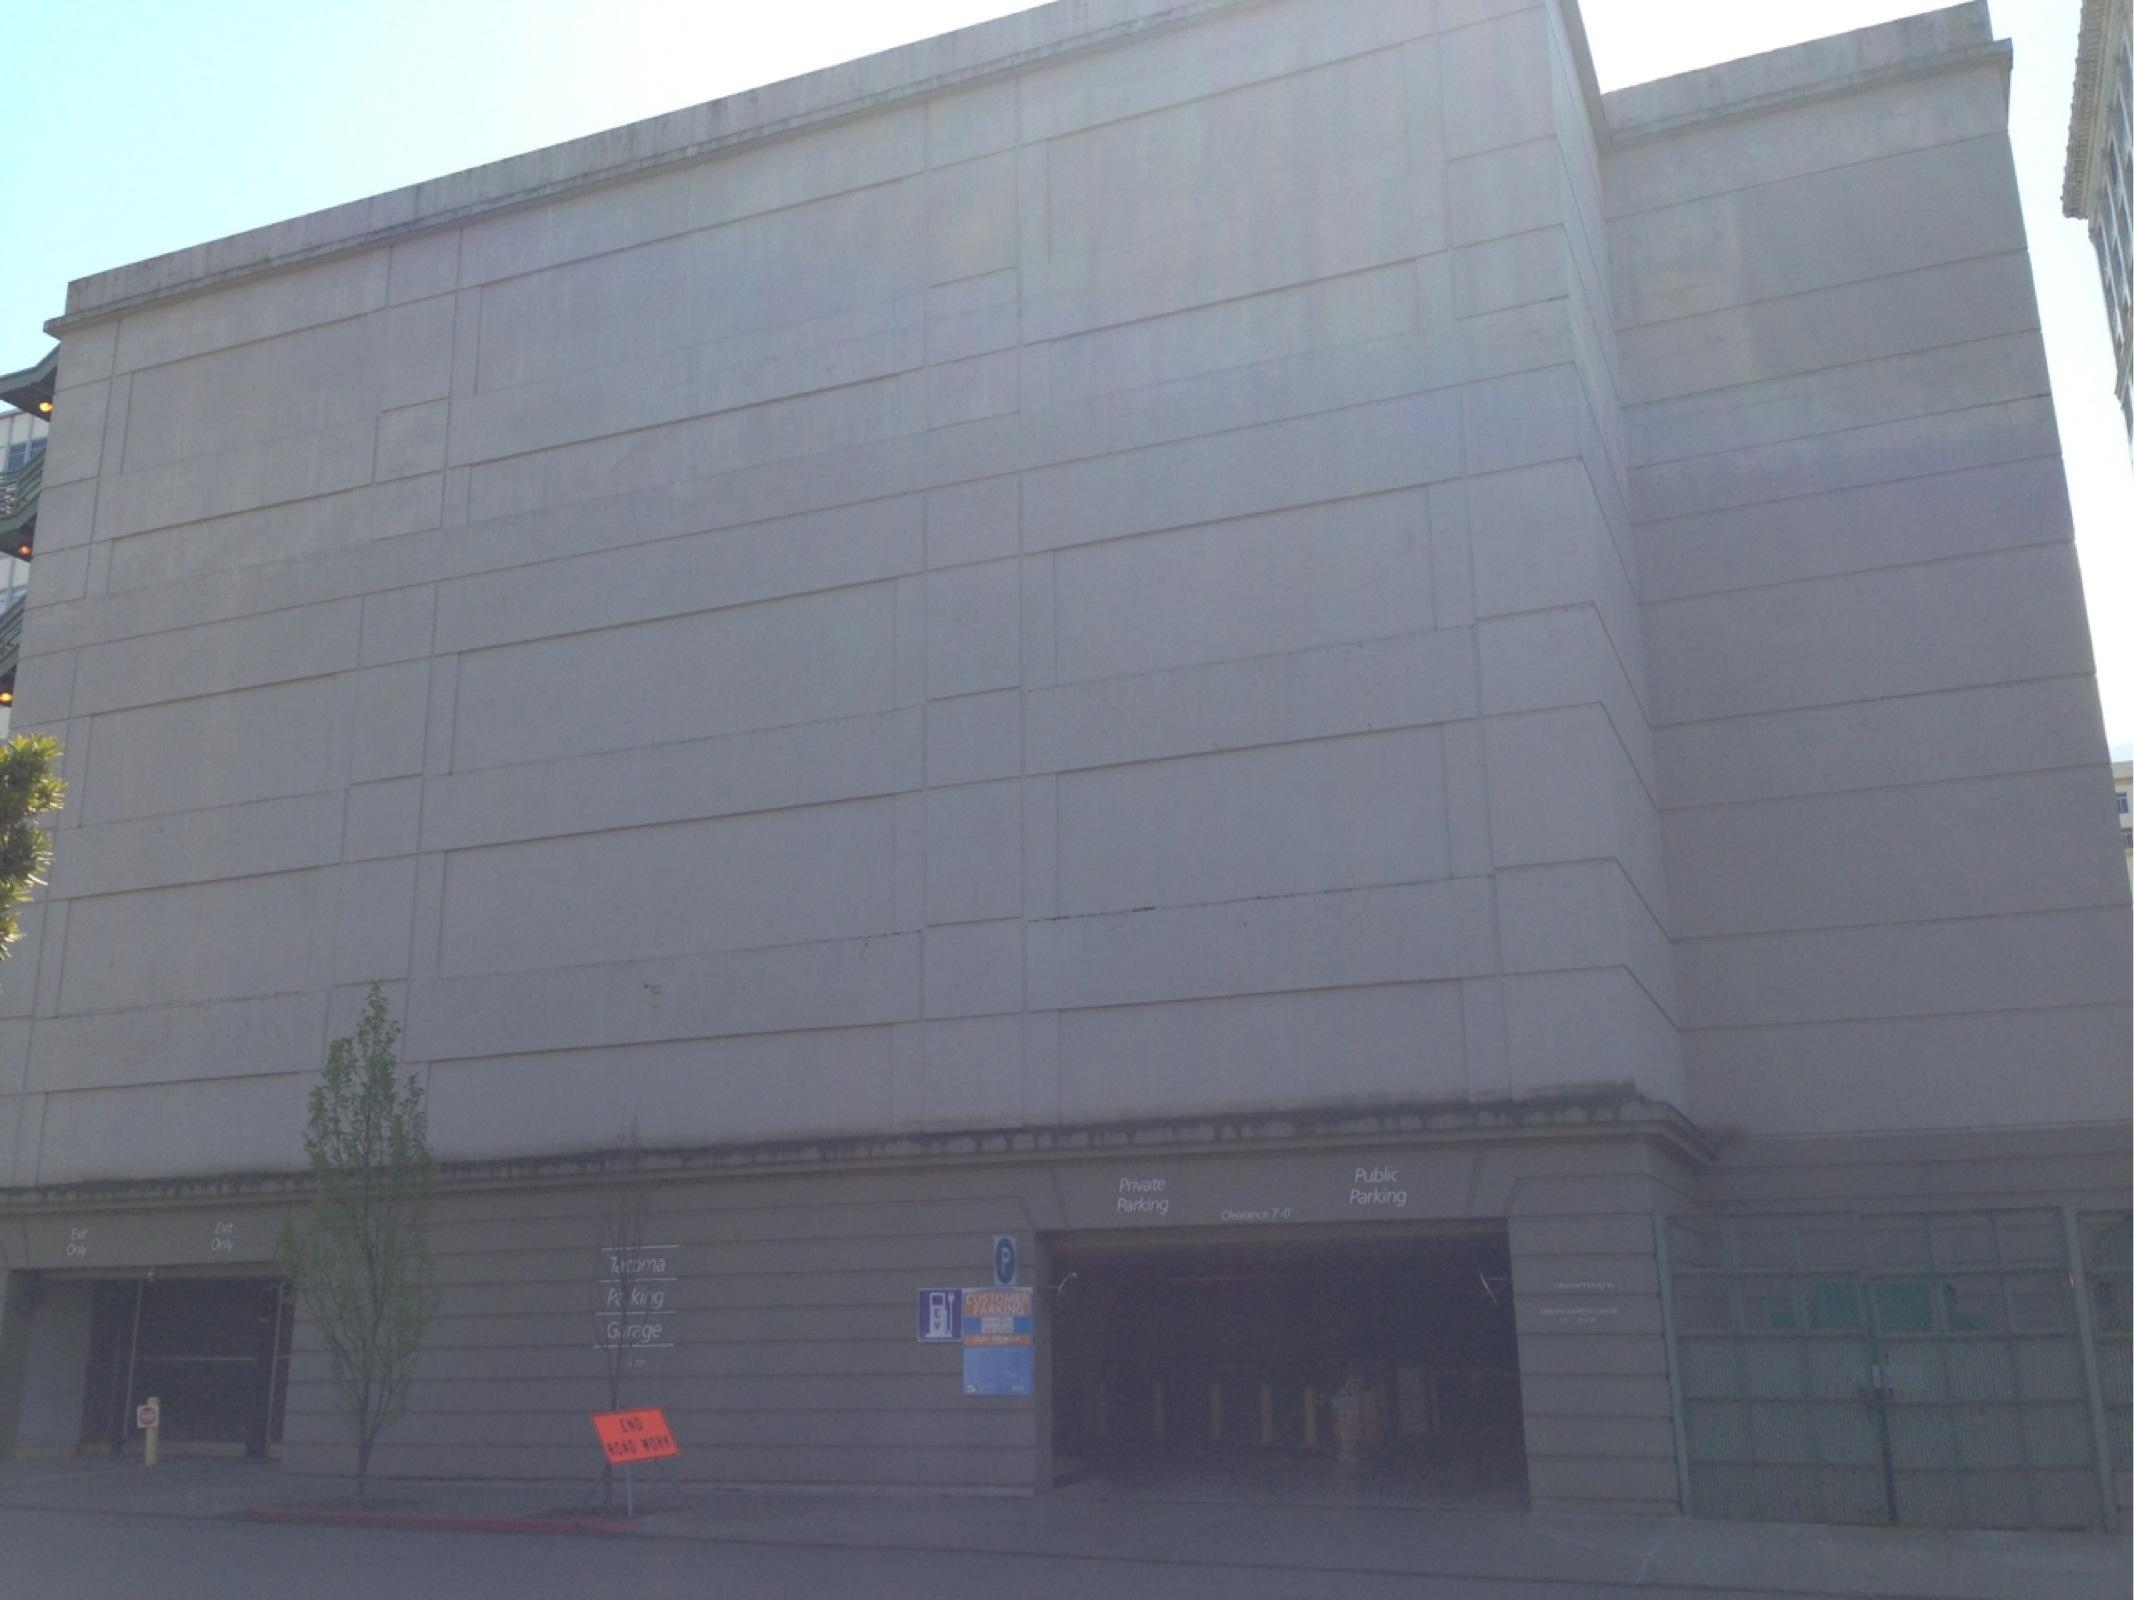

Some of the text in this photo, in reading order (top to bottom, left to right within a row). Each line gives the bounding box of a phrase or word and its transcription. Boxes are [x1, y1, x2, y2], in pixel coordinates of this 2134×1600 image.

[1354, 1166, 1399, 1183] Public
[1119, 1176, 1166, 1192] Private
[1349, 1187, 1408, 1207] Parking
[1117, 1198, 1168, 1215] Parking
[1221, 1209, 1269, 1221] Clearance
[70, 1227, 87, 1240] Exit
[213, 1222, 233, 1234] Exit
[66, 1243, 88, 1257] Only
[211, 1238, 234, 1252] Only
[1002, 1247, 1009, 1275] P
[608, 1287, 665, 1310] Paking
[966, 1292, 1029, 1305] CUSTOMER
[973, 1304, 1024, 1315] PARKING
[620, 1417, 643, 1433] END
[607, 1434, 670, 1456] ROAD WORK
